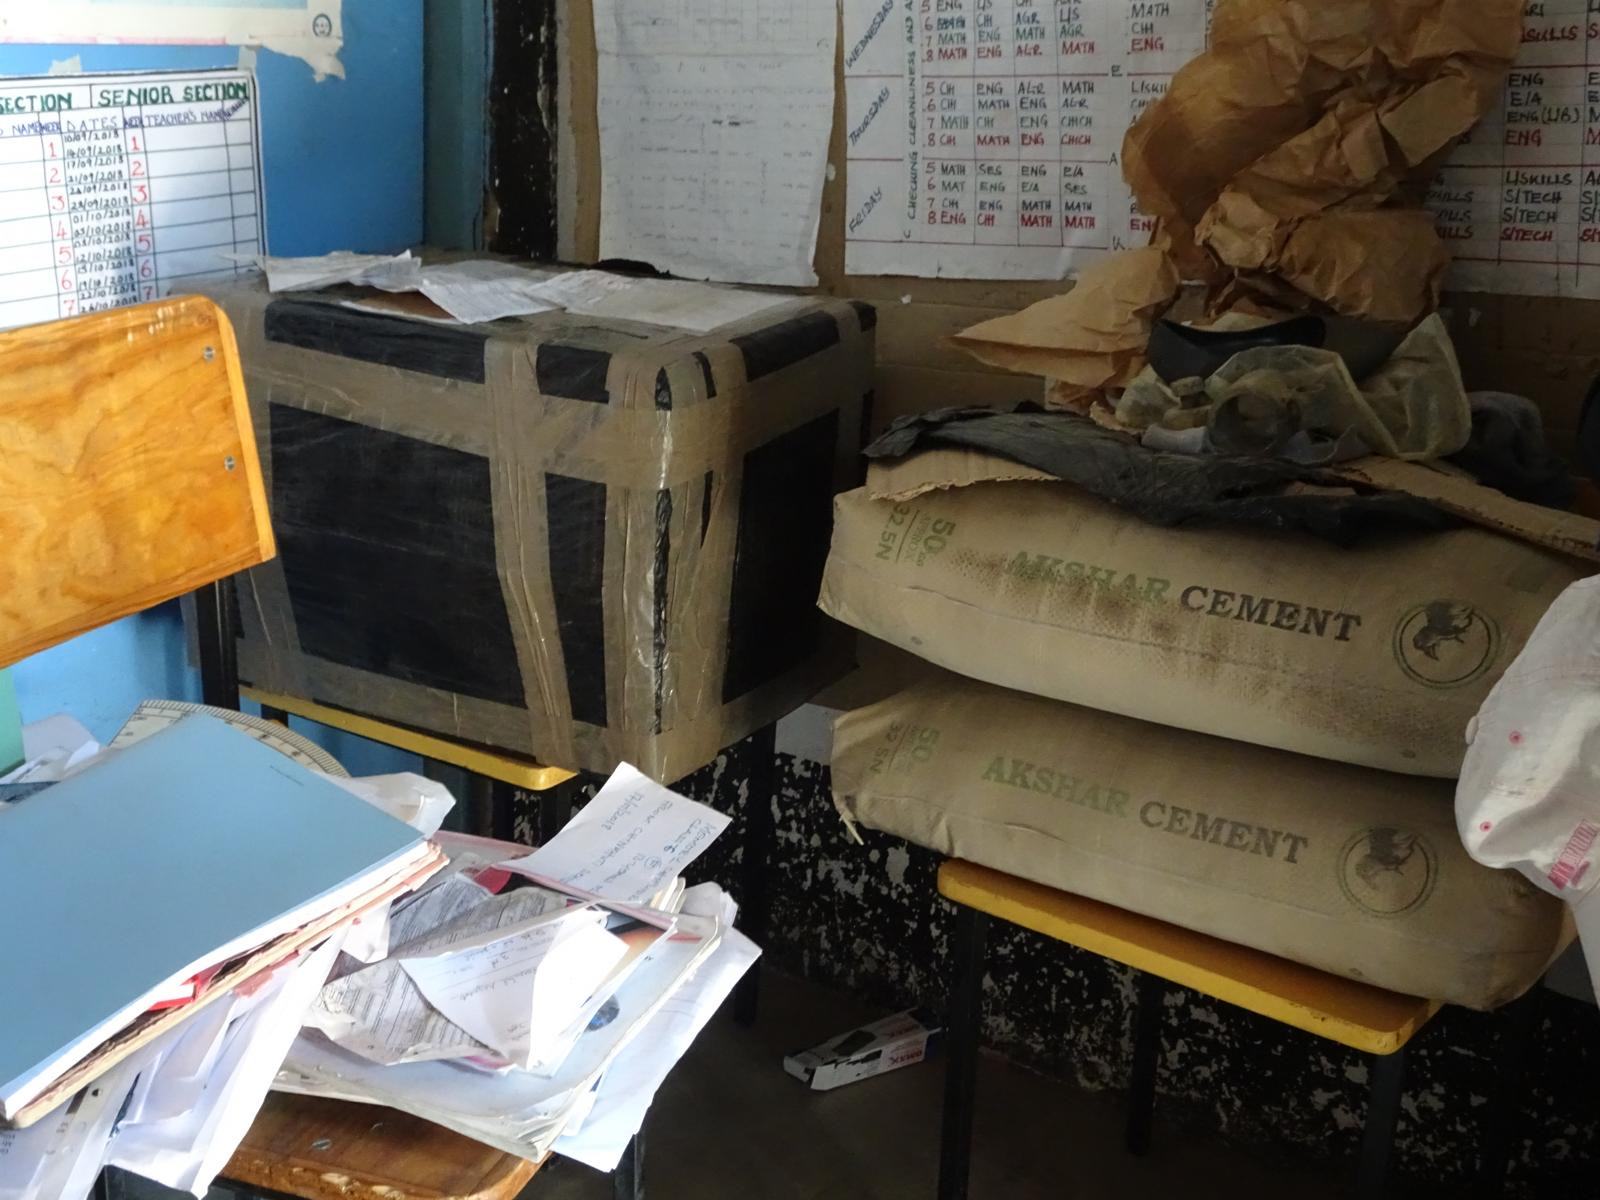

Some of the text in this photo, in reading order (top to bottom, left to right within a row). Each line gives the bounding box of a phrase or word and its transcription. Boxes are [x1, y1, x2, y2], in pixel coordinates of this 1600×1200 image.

[1131, 3, 1169, 17] MATH
[905, 17, 914, 43] AND
[925, 16, 933, 31] 6
[926, 36, 932, 47] 7
[938, 32, 966, 46] MATH
[979, 27, 1000, 43] ENG
[1016, 27, 1045, 40] MATH
[1131, 37, 1164, 51] ENG
[927, 49, 933, 62] 8
[938, 48, 967, 60] MATH
[977, 45, 1002, 58] ENG
[1062, 41, 1095, 55] MATH
[1508, 73, 1544, 87] ENG
[98, 82, 248, 107] SENIOR SECTION
[926, 82, 935, 95] 5
[977, 83, 1003, 95] ENG
[1062, 82, 1094, 95] MATH
[908, 51, 917, 145] CLEANLINESS
[927, 101, 936, 112] 6
[978, 101, 1010, 111] MATH
[1020, 97, 1047, 110] ENG
[1510, 91, 1542, 106] E/A
[66, 116, 118, 132] DATES
[928, 119, 935, 130] 7
[941, 117, 969, 129] MATH
[1020, 114, 1048, 128] ENG
[131, 136, 140, 151] 1
[928, 133, 935, 146] 8
[977, 134, 1010, 146] MATH
[1021, 132, 1045, 146] ENG
[1505, 128, 1542, 147] ENG
[49, 142, 56, 157] 1
[49, 167, 61, 183] 2
[132, 161, 144, 176] 2
[926, 163, 936, 174] 5
[941, 165, 966, 176] MATH
[1021, 166, 1047, 177] ENG
[908, 151, 918, 220] CHECKING
[927, 177, 936, 190] 6
[980, 182, 1005, 193] ENG
[133, 185, 147, 204] 3
[52, 195, 66, 211] 3
[849, 187, 882, 233] FRIDAY
[928, 198, 935, 208] 7
[979, 200, 1003, 211] ENG
[1022, 200, 1051, 211] MATH
[1065, 202, 1092, 212] MATH
[136, 208, 149, 228] 4
[928, 212, 936, 225] 8
[940, 213, 967, 225] ENG
[1020, 215, 1052, 228] MATH
[1065, 216, 1095, 229] MATH
[56, 220, 67, 240] 4
[138, 234, 151, 254] 5
[59, 246, 72, 264] 5
[141, 260, 152, 278] 6
[61, 270, 72, 290] 6
[143, 286, 152, 300] 7
[64, 300, 75, 315] 7
[923, 517, 956, 555] 50
[1006, 551, 1361, 642] AKSHAR CEMENT
[981, 756, 1308, 864] AKSHAR CEMENT
